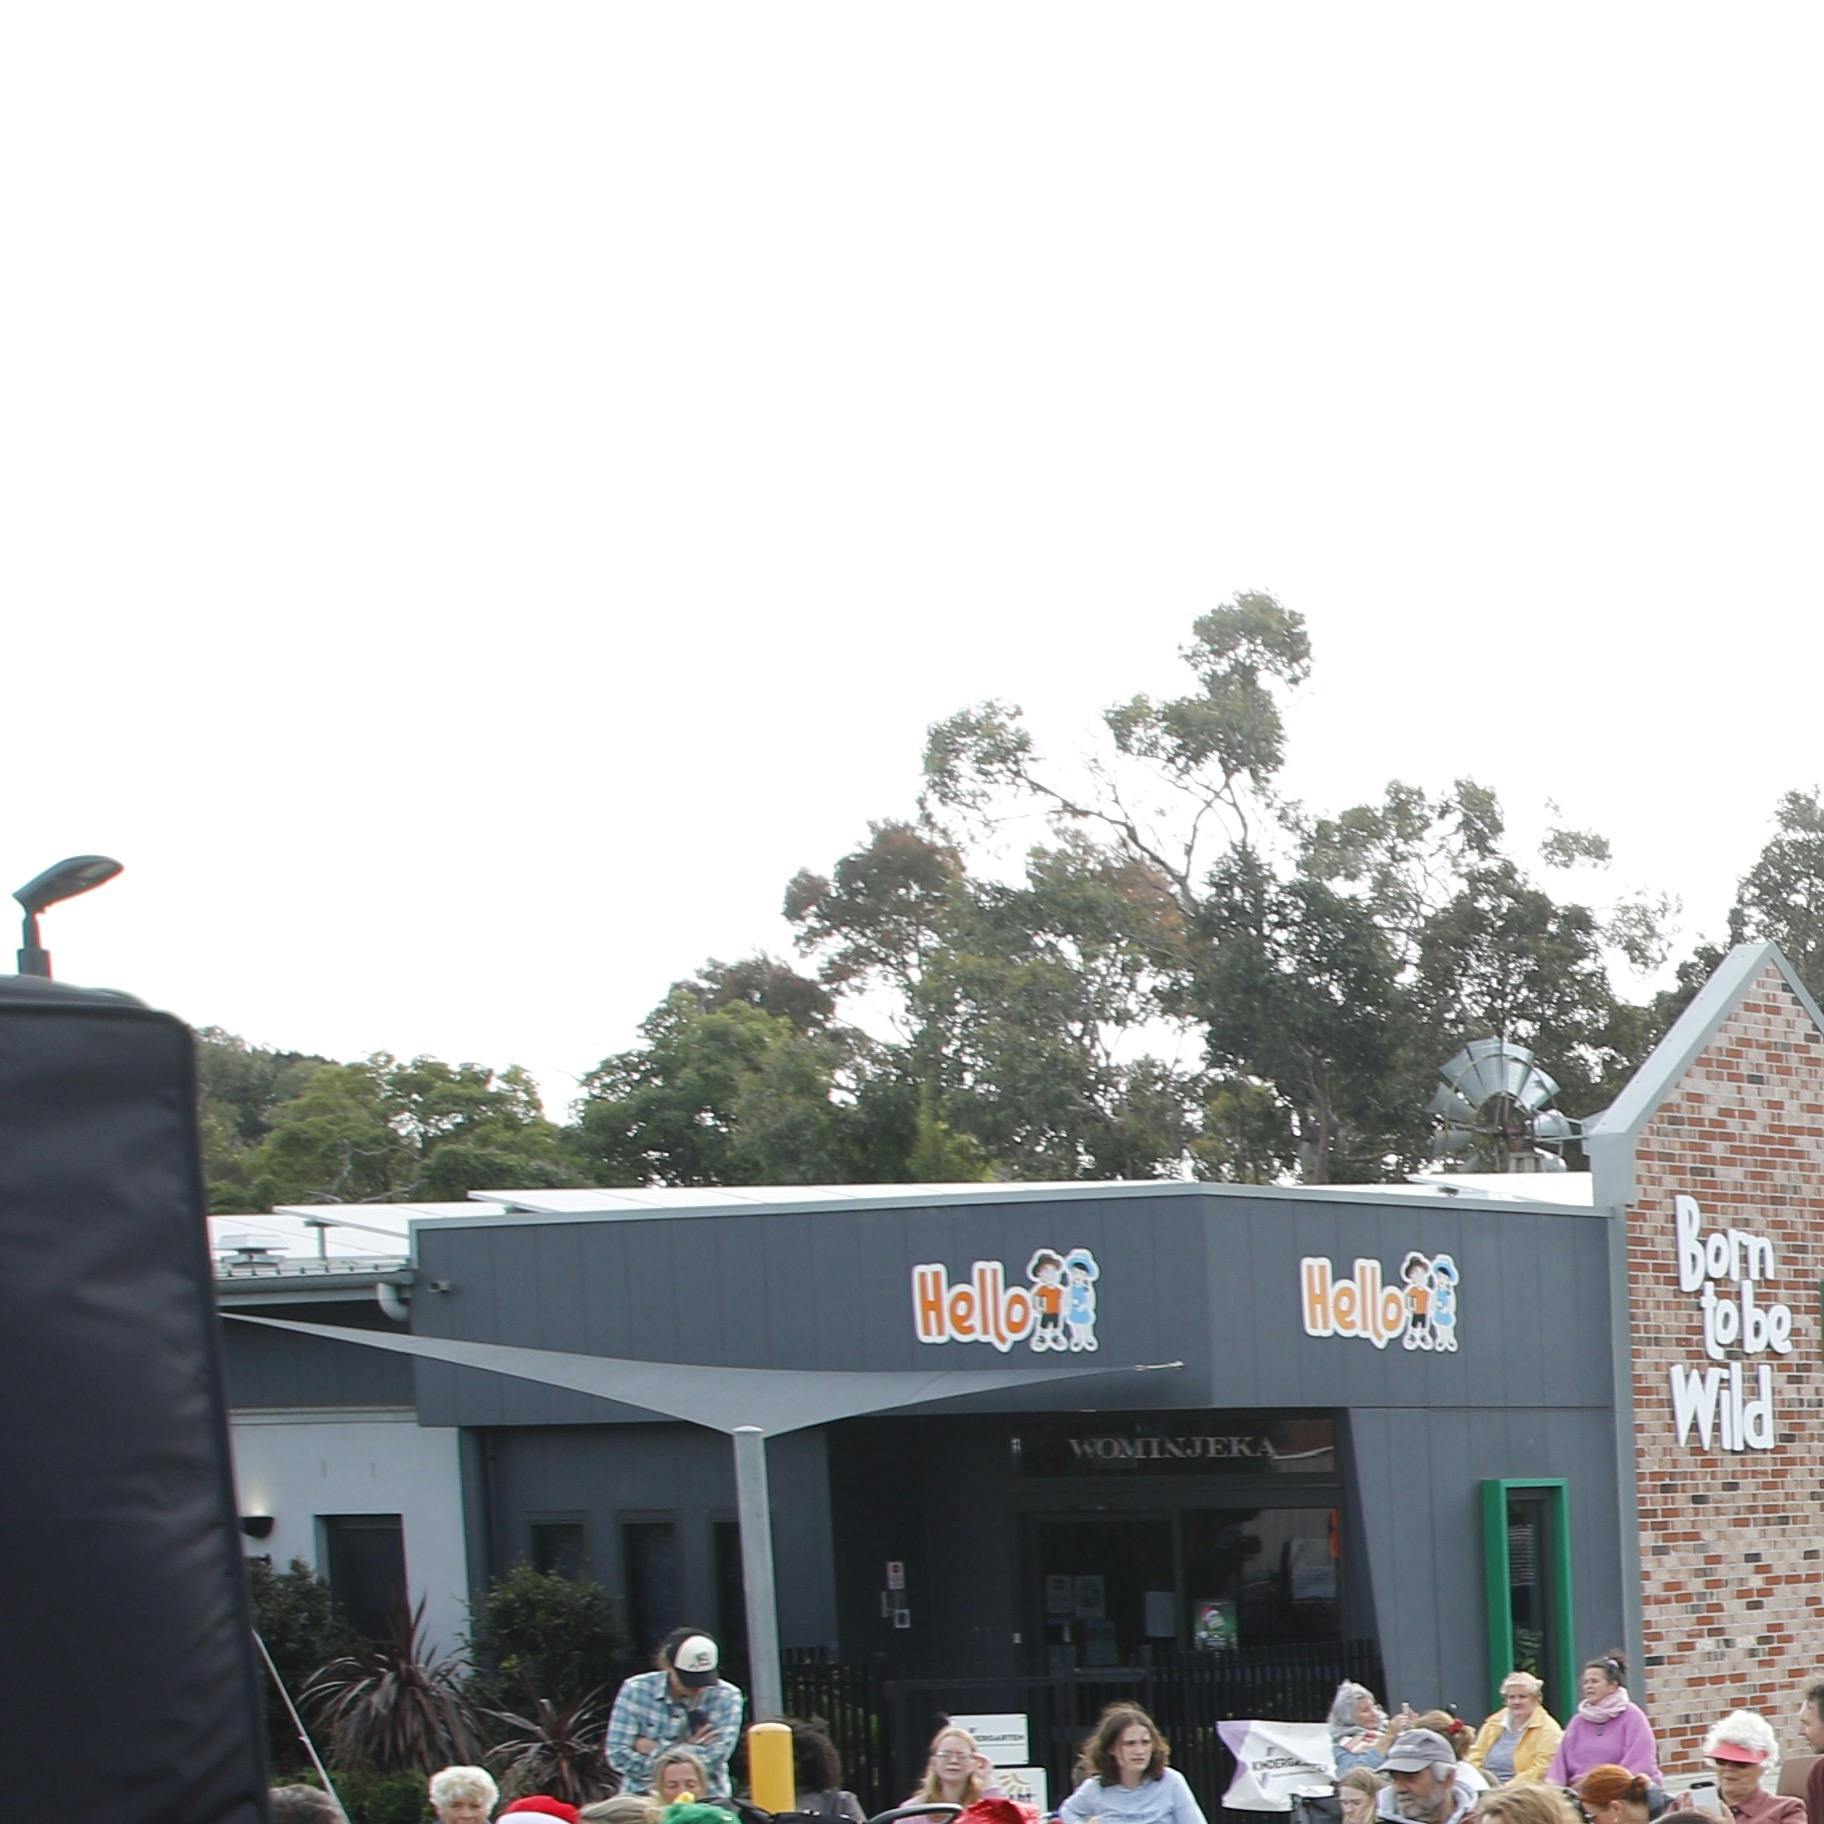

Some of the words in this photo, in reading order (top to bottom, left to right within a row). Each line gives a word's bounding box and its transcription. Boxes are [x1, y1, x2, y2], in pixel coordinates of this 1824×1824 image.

[1675, 1195, 1775, 1292] Born
[916, 1266, 1031, 1346] Hello
[1304, 1260, 1405, 1344] Hello
[1700, 1281, 1739, 1360] to
[1741, 1280, 1792, 1354] be
[1069, 1436, 1275, 1459] WOMINJEKA
[1670, 1362, 1775, 1451] Wild
